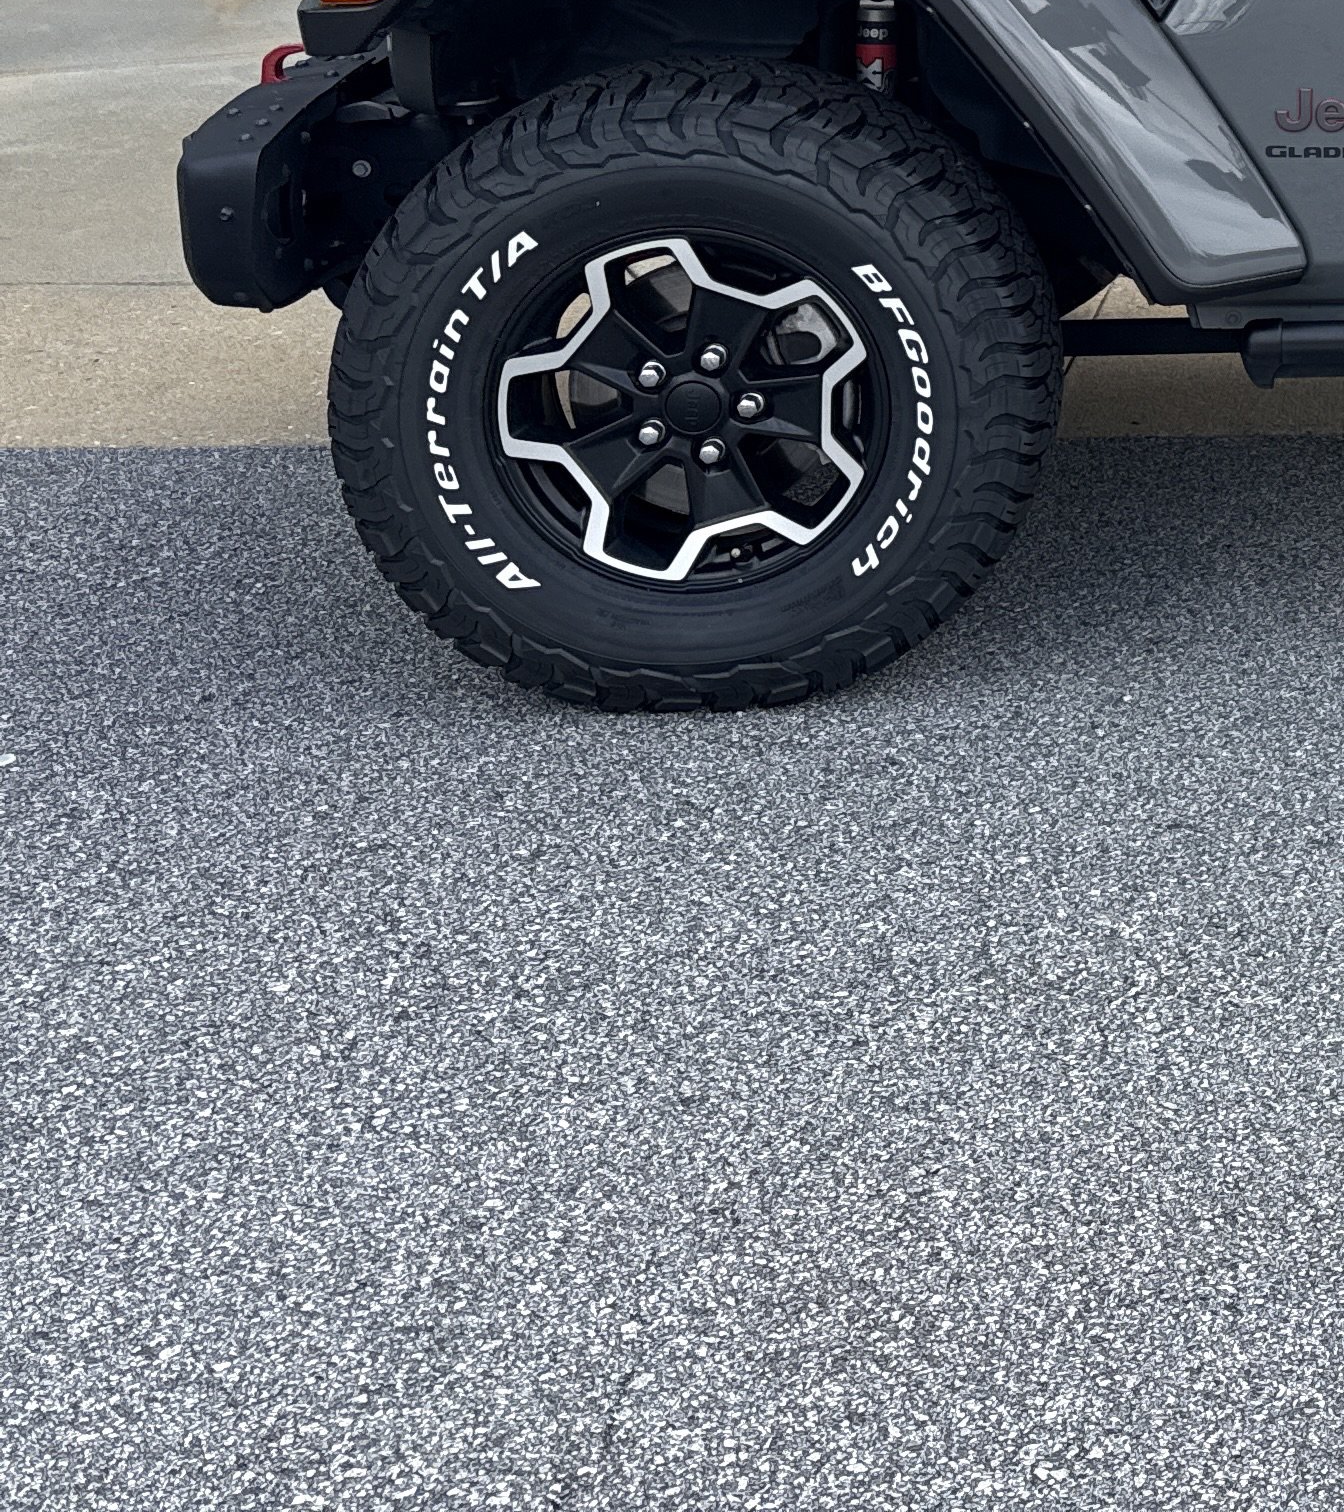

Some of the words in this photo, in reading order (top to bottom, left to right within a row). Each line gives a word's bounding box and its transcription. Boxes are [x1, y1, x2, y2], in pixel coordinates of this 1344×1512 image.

[857, 27, 889, 41] Jeep
[460, 229, 540, 301] T/A
[426, 309, 542, 590] All-Terrain
[850, 262, 935, 578] BFGoodrich
